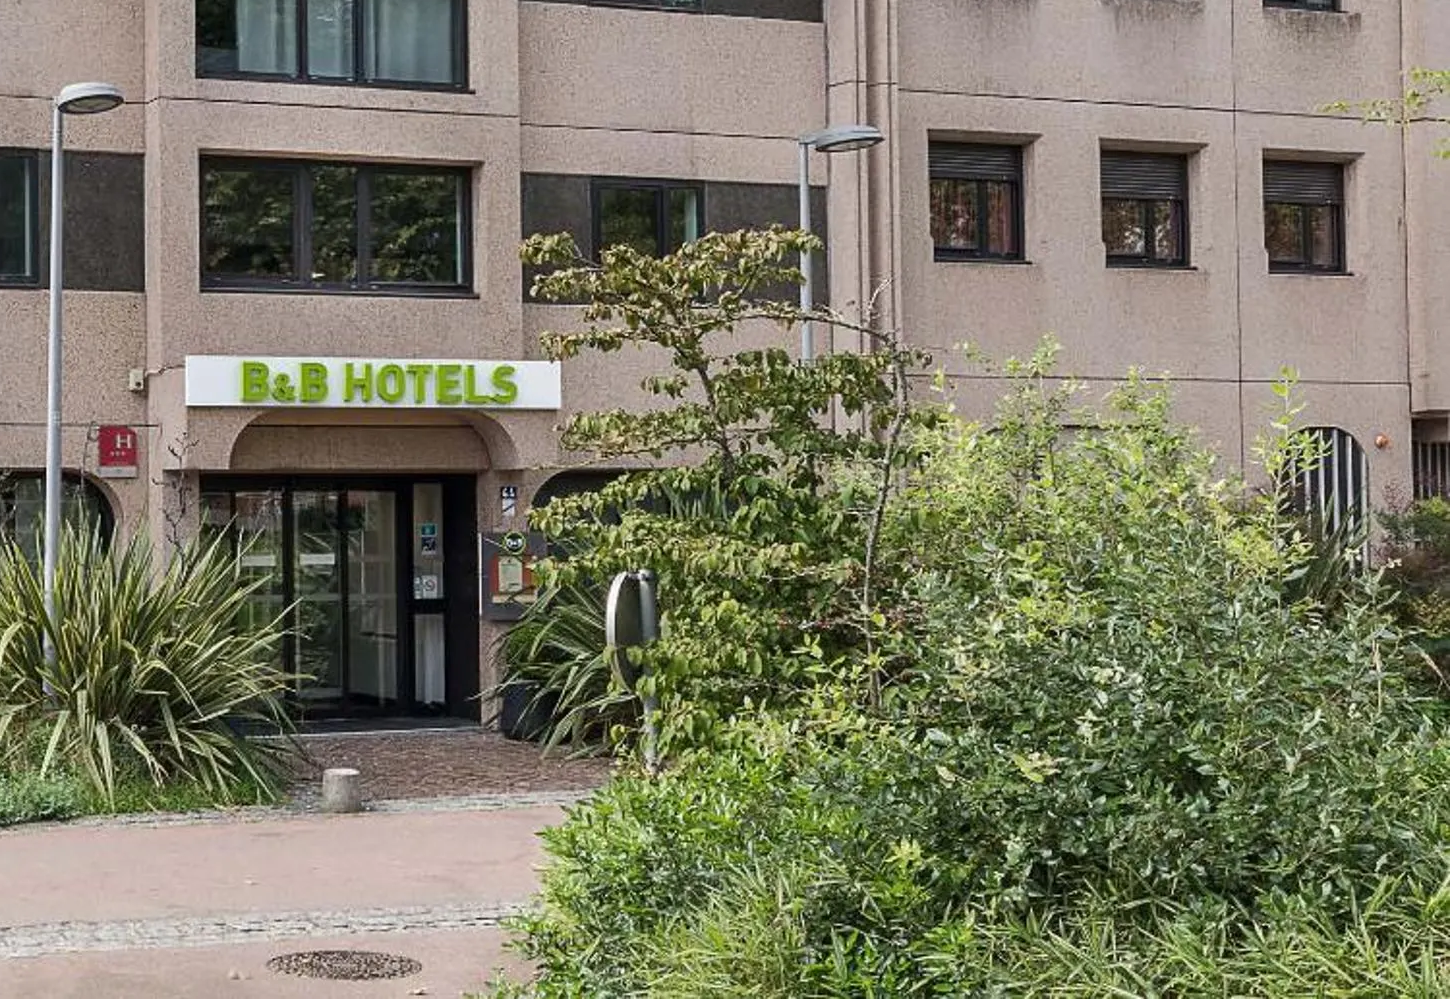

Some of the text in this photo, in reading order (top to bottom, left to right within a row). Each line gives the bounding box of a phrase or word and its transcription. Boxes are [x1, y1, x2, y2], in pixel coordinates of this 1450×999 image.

[242, 360, 519, 404] B&B HOTELS
[116, 433, 131, 449] H
